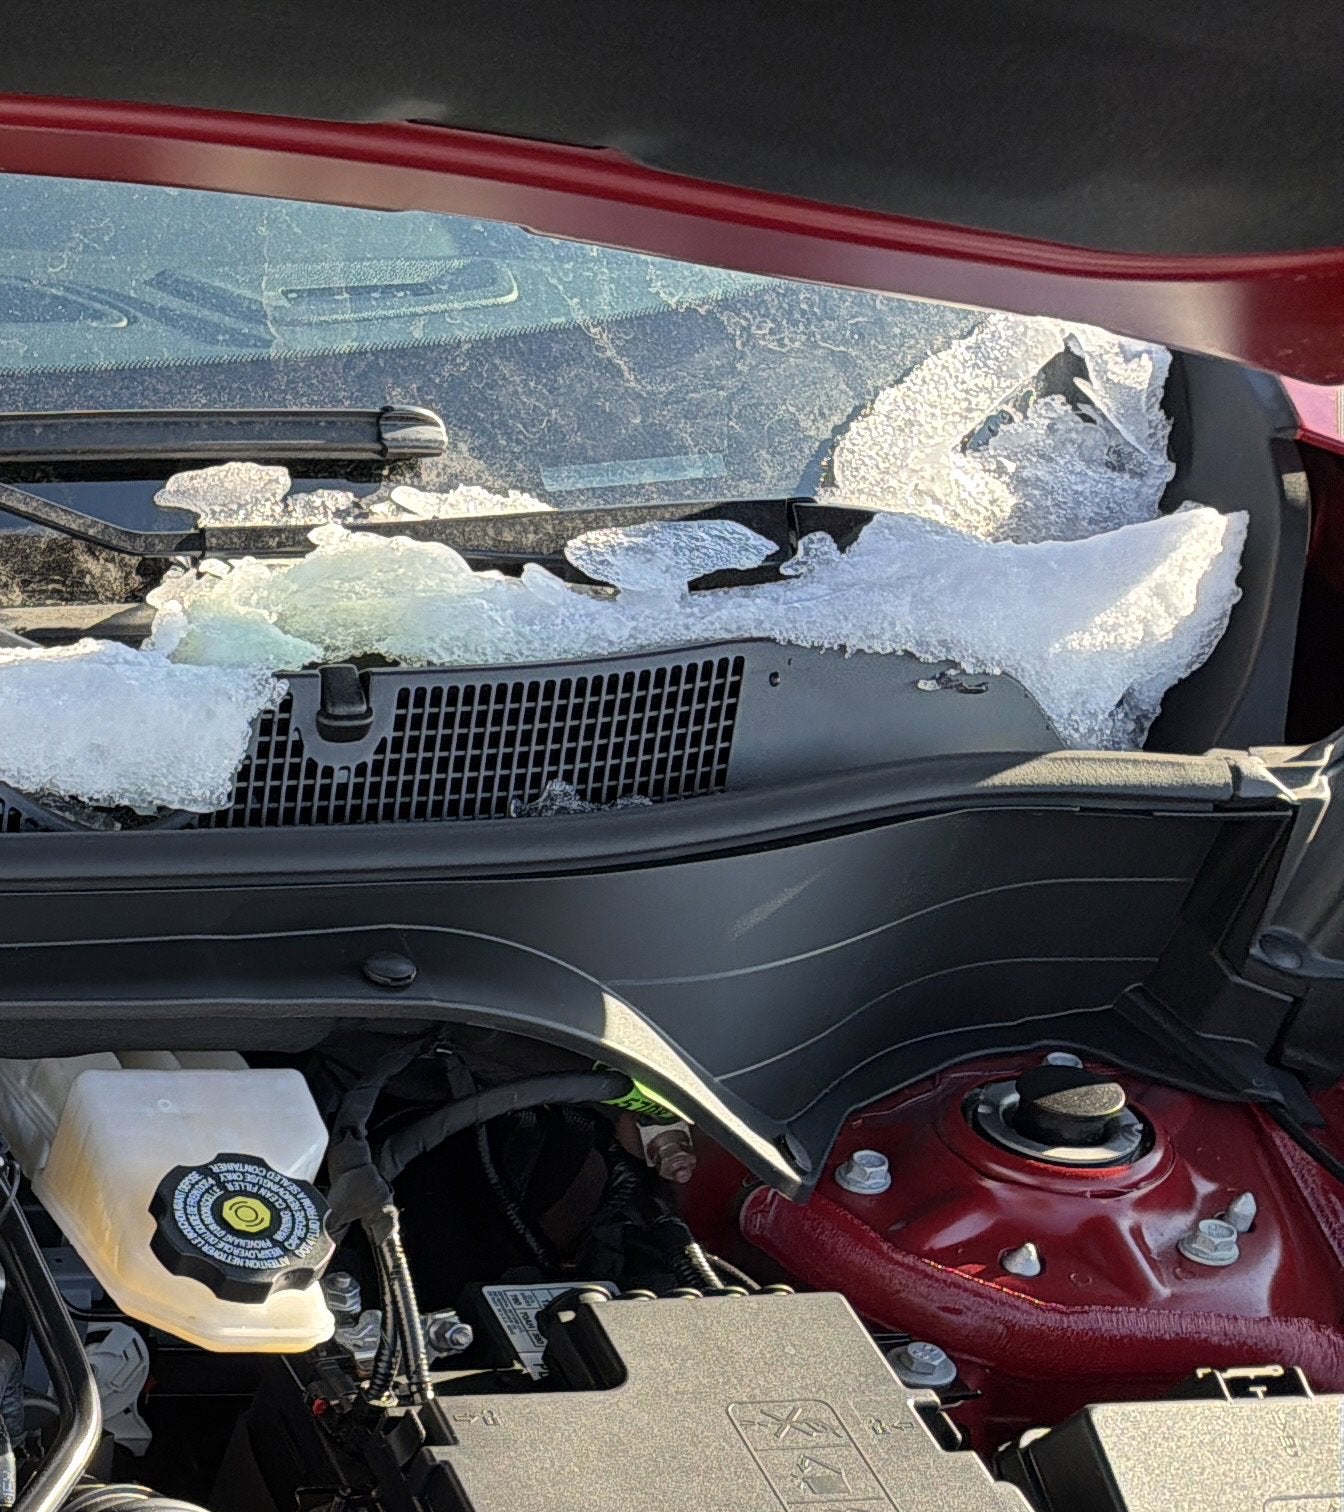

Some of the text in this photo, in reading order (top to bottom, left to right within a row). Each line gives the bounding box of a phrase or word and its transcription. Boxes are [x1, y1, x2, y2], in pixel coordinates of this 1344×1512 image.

[214, 1171, 243, 1183] ONLY
[223, 1181, 259, 1194] FILLER
[264, 1168, 303, 1195] SEALED
[256, 1186, 287, 1209] CLEAN
[297, 1196, 319, 1219] FROM
[305, 1219, 320, 1242] FLUID
